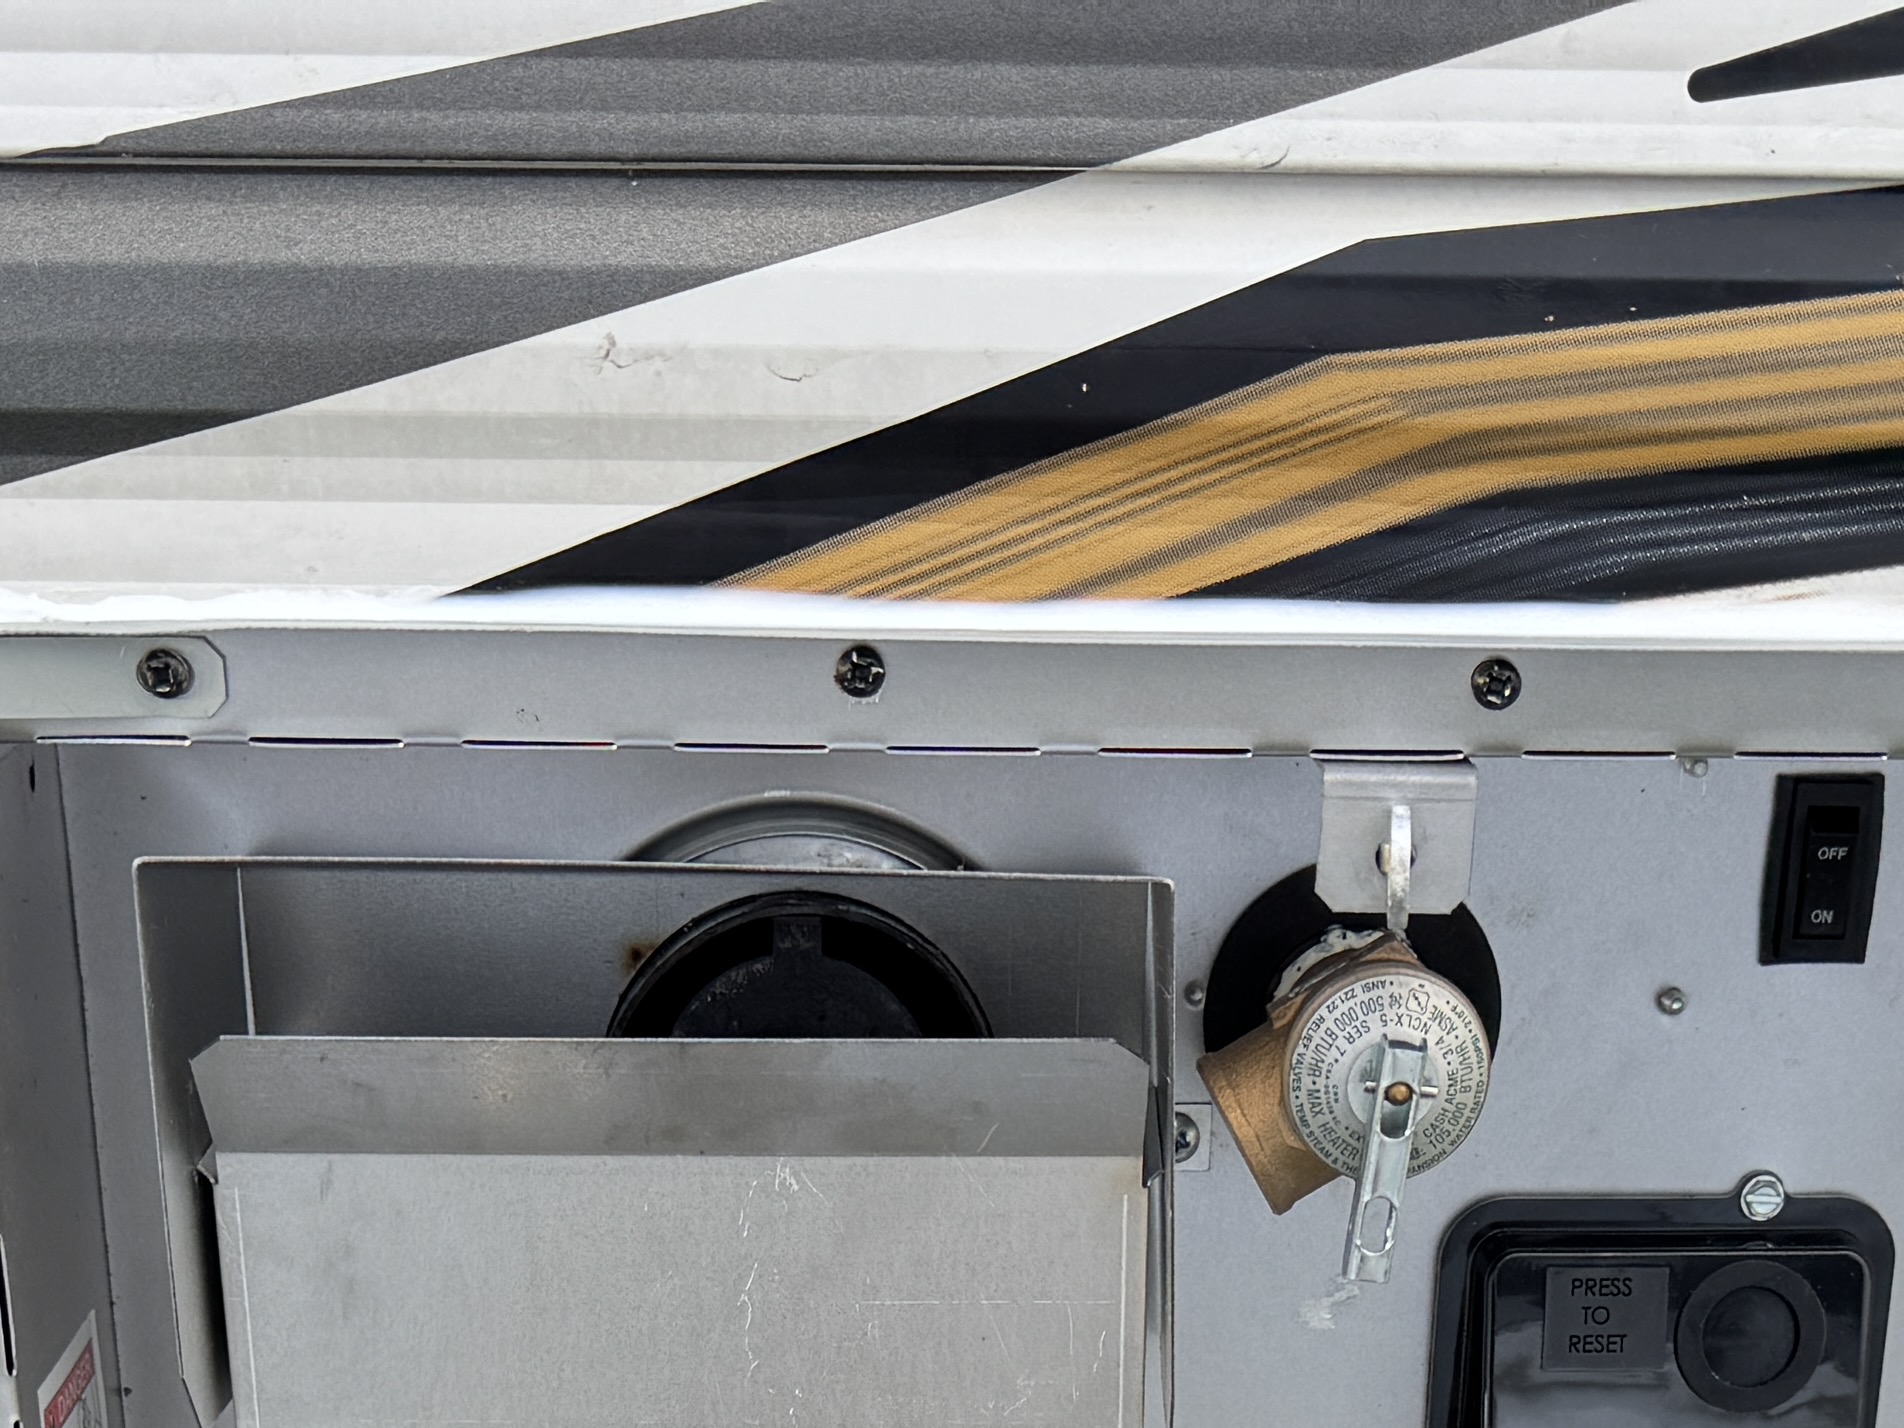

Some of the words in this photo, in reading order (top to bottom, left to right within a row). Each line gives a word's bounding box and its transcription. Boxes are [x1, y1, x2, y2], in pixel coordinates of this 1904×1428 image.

[1817, 846, 1848, 860] OFF
[1811, 909, 1834, 924] ON
[1360, 979, 1387, 996] ANSI
[1334, 996, 1384, 1027] 500,000
[1380, 1012, 1432, 1036] NCLX-5
[1432, 1004, 1456, 1038] ASME
[1301, 1014, 1325, 1048] RELIEF
[1347, 1019, 1371, 1045] SER
[1309, 1028, 1338, 1078] BTU/HR
[1336, 1046, 1346, 1057] 7
[1435, 1035, 1456, 1060] 3/4
[1292, 1049, 1307, 1093] VALVES
[1455, 1039, 1475, 1094] BTU/HR
[1445, 1067, 1459, 1106] ACME
[1294, 1102, 1311, 1131] TEMP
[1306, 1088, 1325, 1119] MAX
[1450, 1117, 1474, 1148] WATER
[1472, 1079, 1486, 1117] RATED
[1423, 1107, 1452, 1138] CASH
[1305, 1130, 1332, 1160] STEAM
[1318, 1121, 1360, 1161] HEATER
[1570, 1277, 1633, 1297] PRESS
[1581, 1306, 1610, 1325] TO
[1568, 1334, 1627, 1354] RESET
